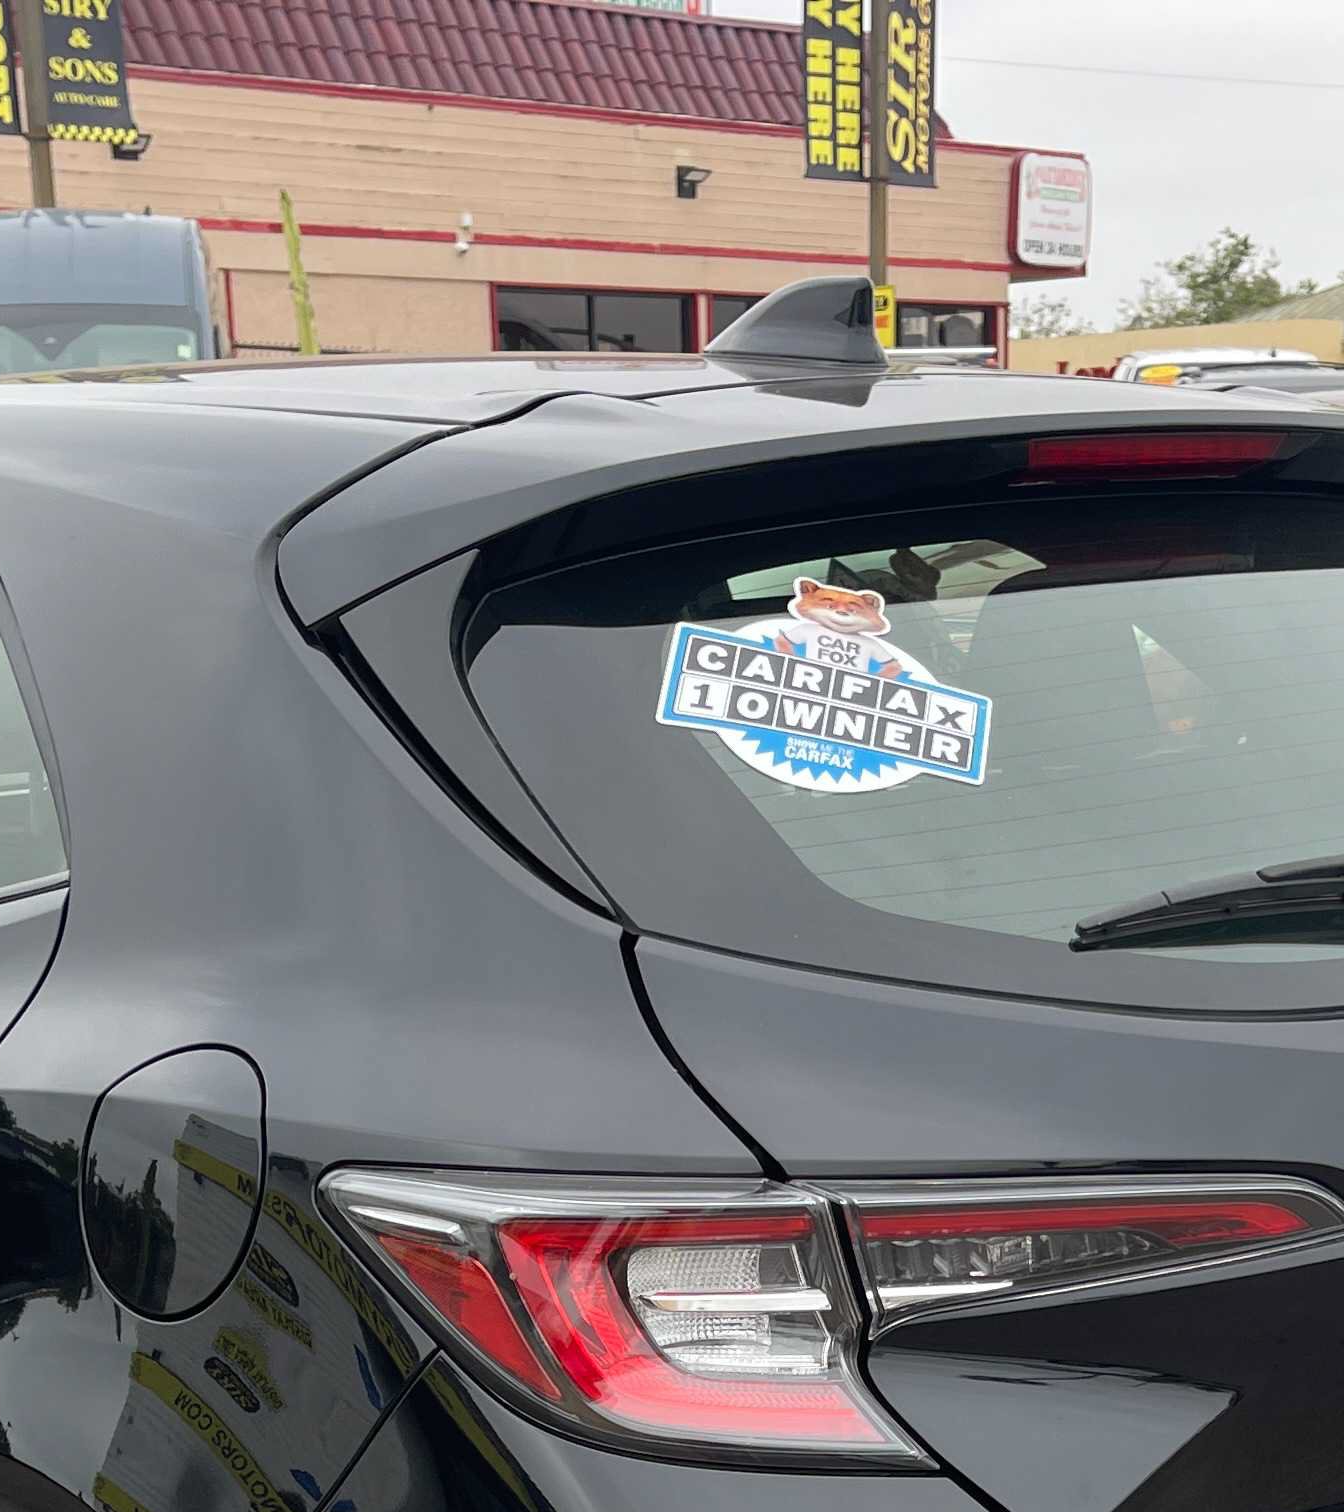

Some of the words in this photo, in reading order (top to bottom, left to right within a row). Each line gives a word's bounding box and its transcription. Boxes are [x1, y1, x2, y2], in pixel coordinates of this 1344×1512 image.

[67, 27, 93, 49] &
[48, 55, 120, 86] SONS
[806, 38, 833, 166] HERE
[886, 0, 917, 173] SIR
[835, 47, 861, 172] HERE
[815, 633, 862, 656] CAR
[816, 649, 859, 669] FOX
[694, 643, 967, 733] CARFAX
[688, 681, 714, 712] 1
[735, 694, 963, 765] OWNER
[784, 745, 853, 769] CARFAX
[786, 736, 818, 751] SHOW
